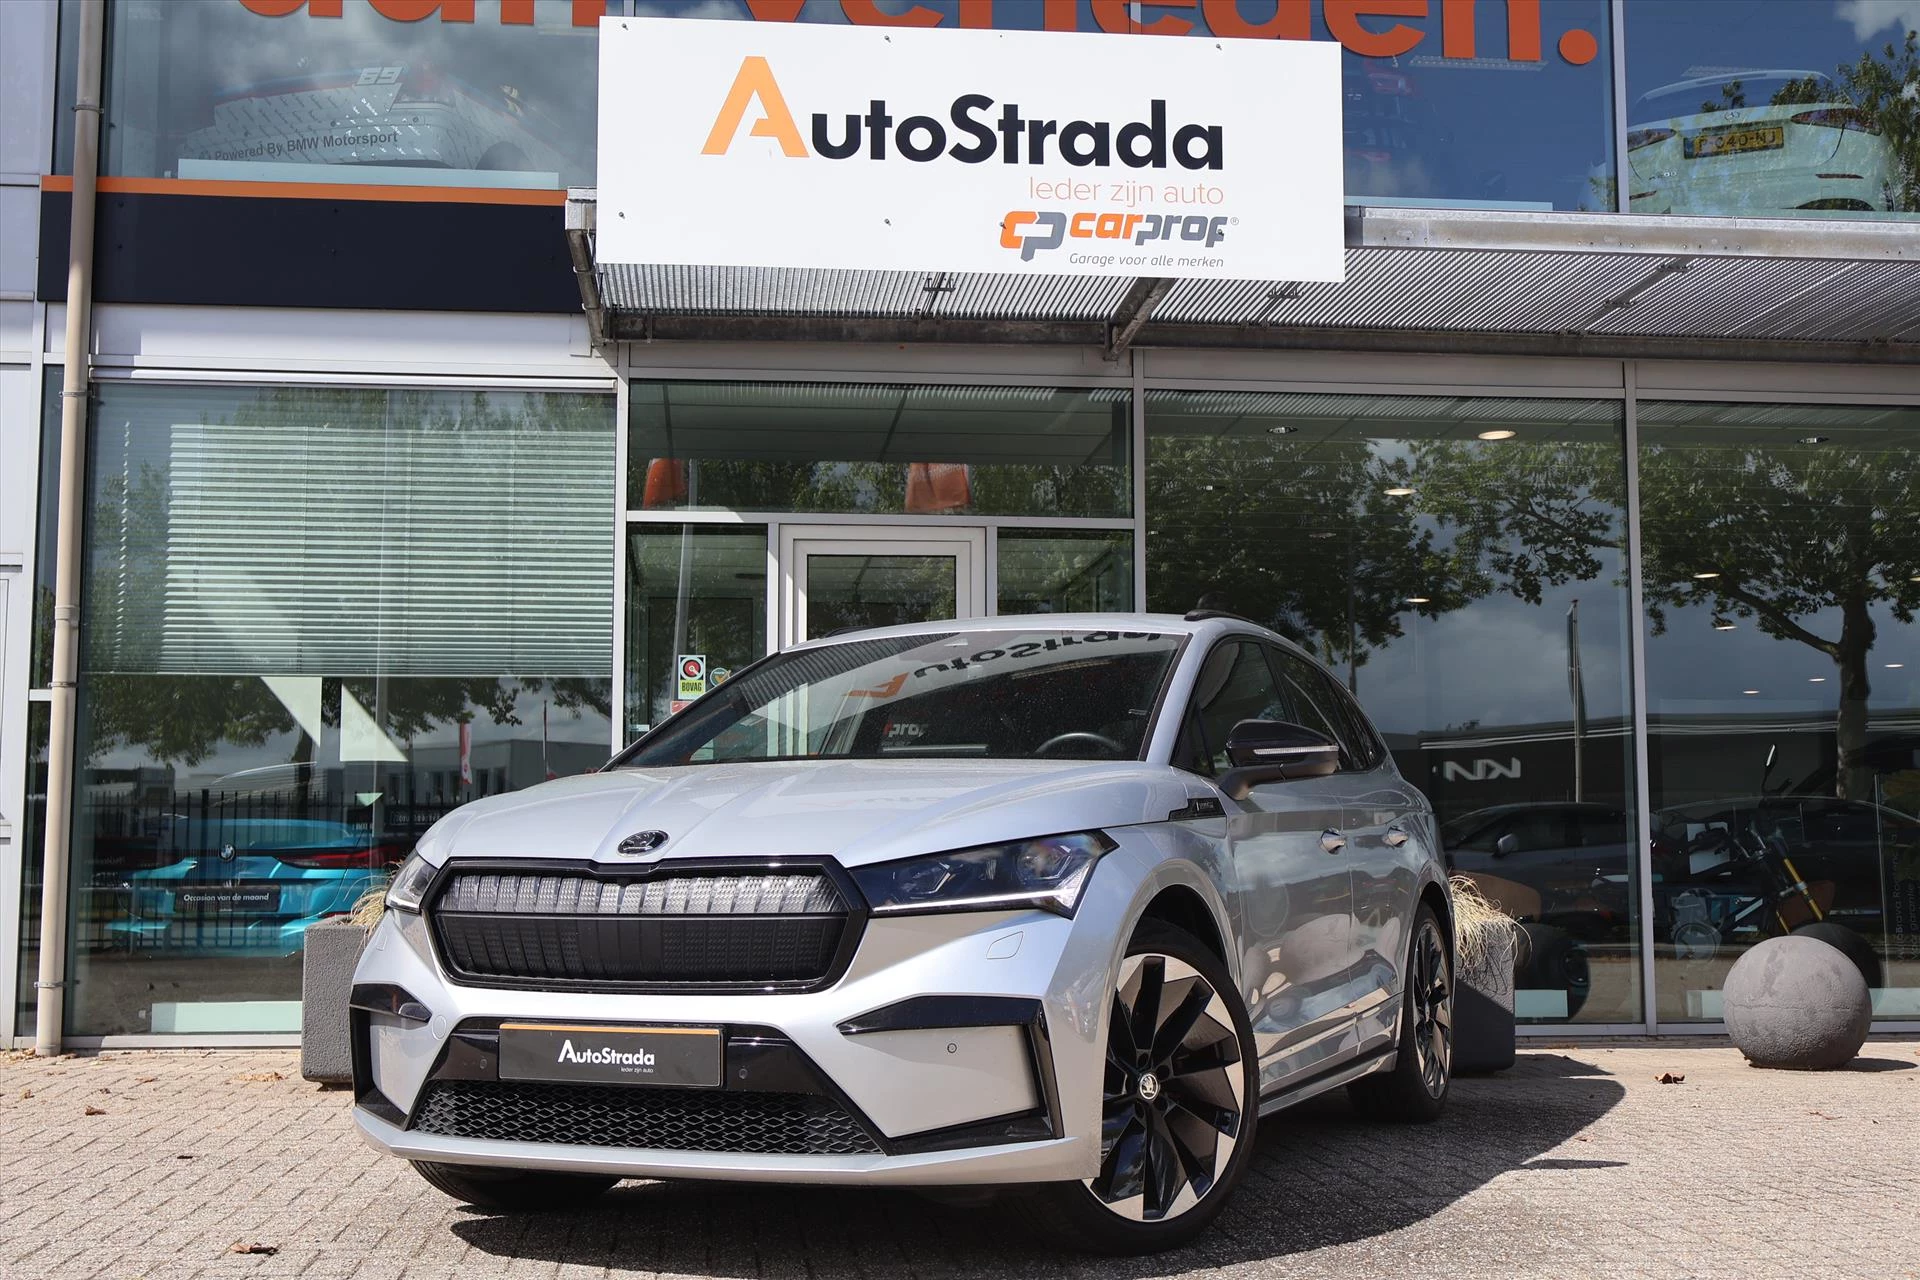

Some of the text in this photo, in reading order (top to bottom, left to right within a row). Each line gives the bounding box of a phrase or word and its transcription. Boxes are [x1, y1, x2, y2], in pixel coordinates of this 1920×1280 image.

[700, 56, 1224, 170] AutoStrada
[214, 143, 264, 160] Powered
[267, 142, 283, 157] By
[287, 136, 320, 152] BMW
[323, 132, 399, 147] Motorsport
[1030, 177, 1224, 208] Ieder zijn auto
[1069, 252, 1224, 268] Garage voor alle merken
[681, 682, 702, 692] BOVAG
[183, 893, 215, 902] Occasion
[232, 893, 242, 901] de
[243, 893, 269, 901] maand
[557, 1039, 655, 1066] AutoStrada
